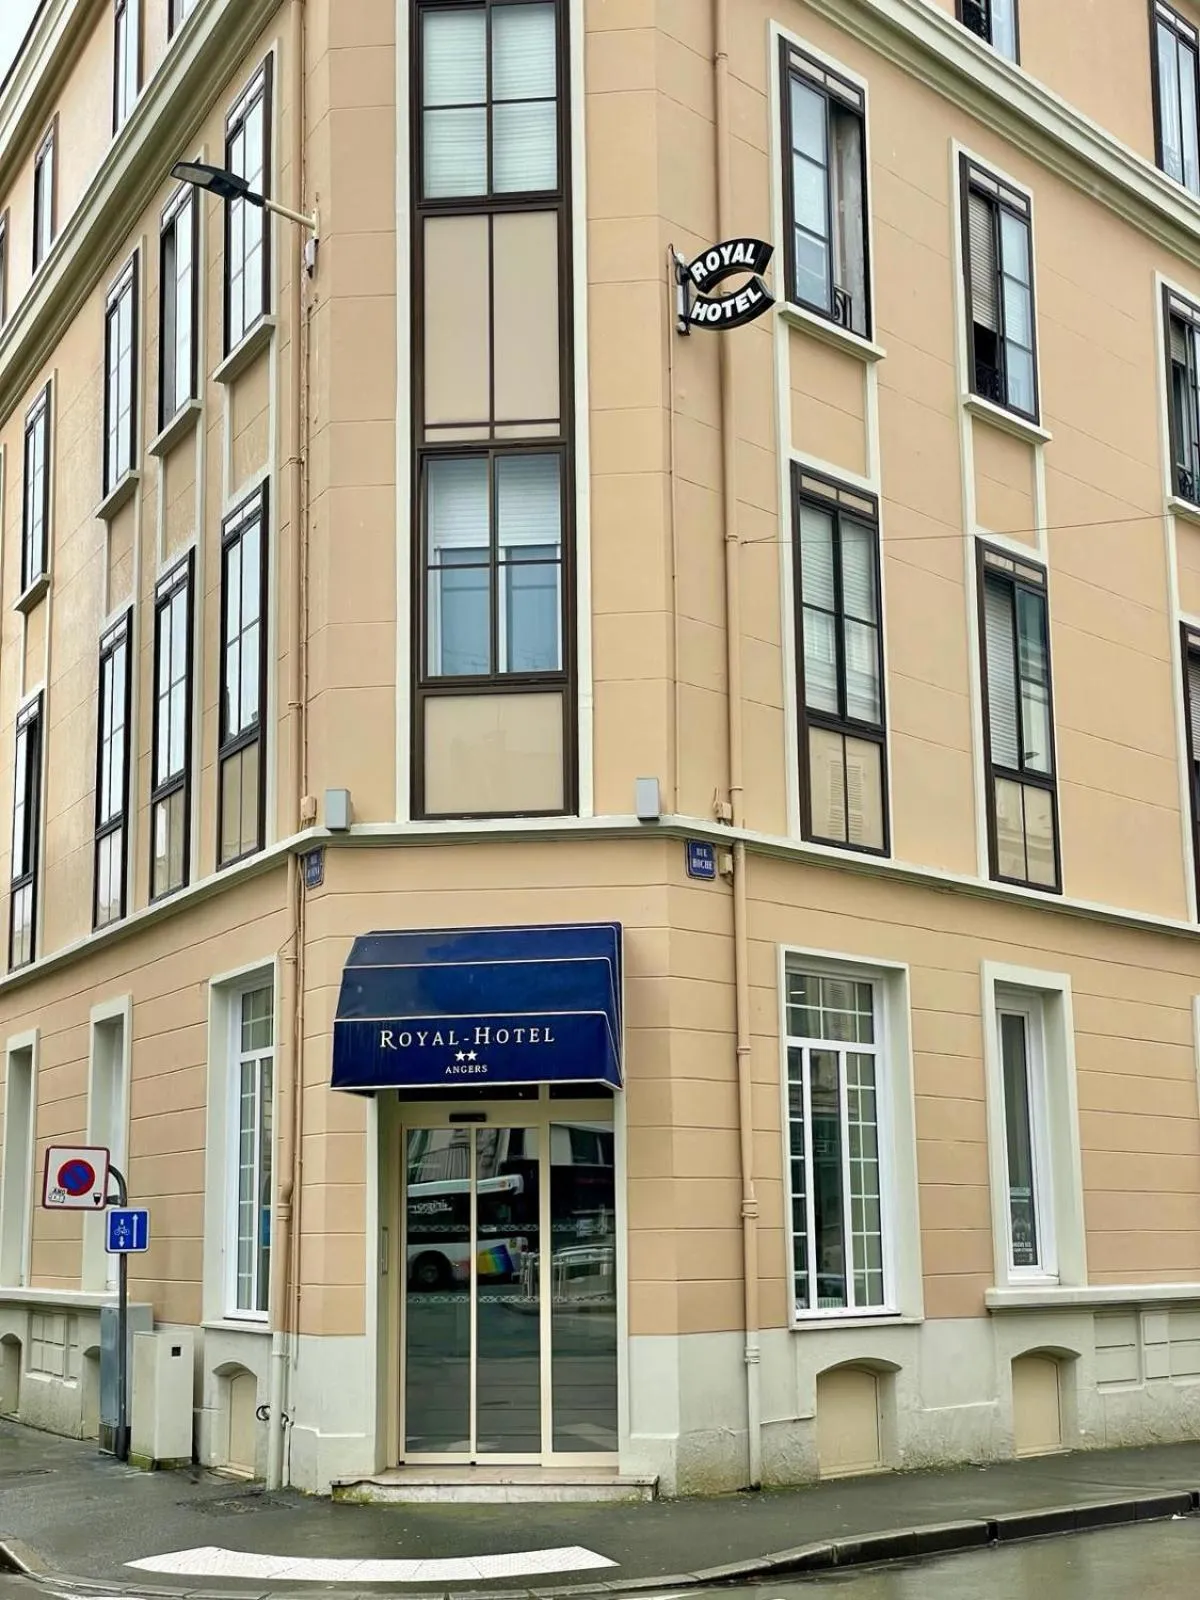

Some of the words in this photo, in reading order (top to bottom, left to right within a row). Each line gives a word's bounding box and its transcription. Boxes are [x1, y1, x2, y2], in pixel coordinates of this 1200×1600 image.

[690, 243, 755, 282] ROYAL
[690, 287, 762, 322] HOTEL
[445, 1064, 488, 1075] ANGERS
